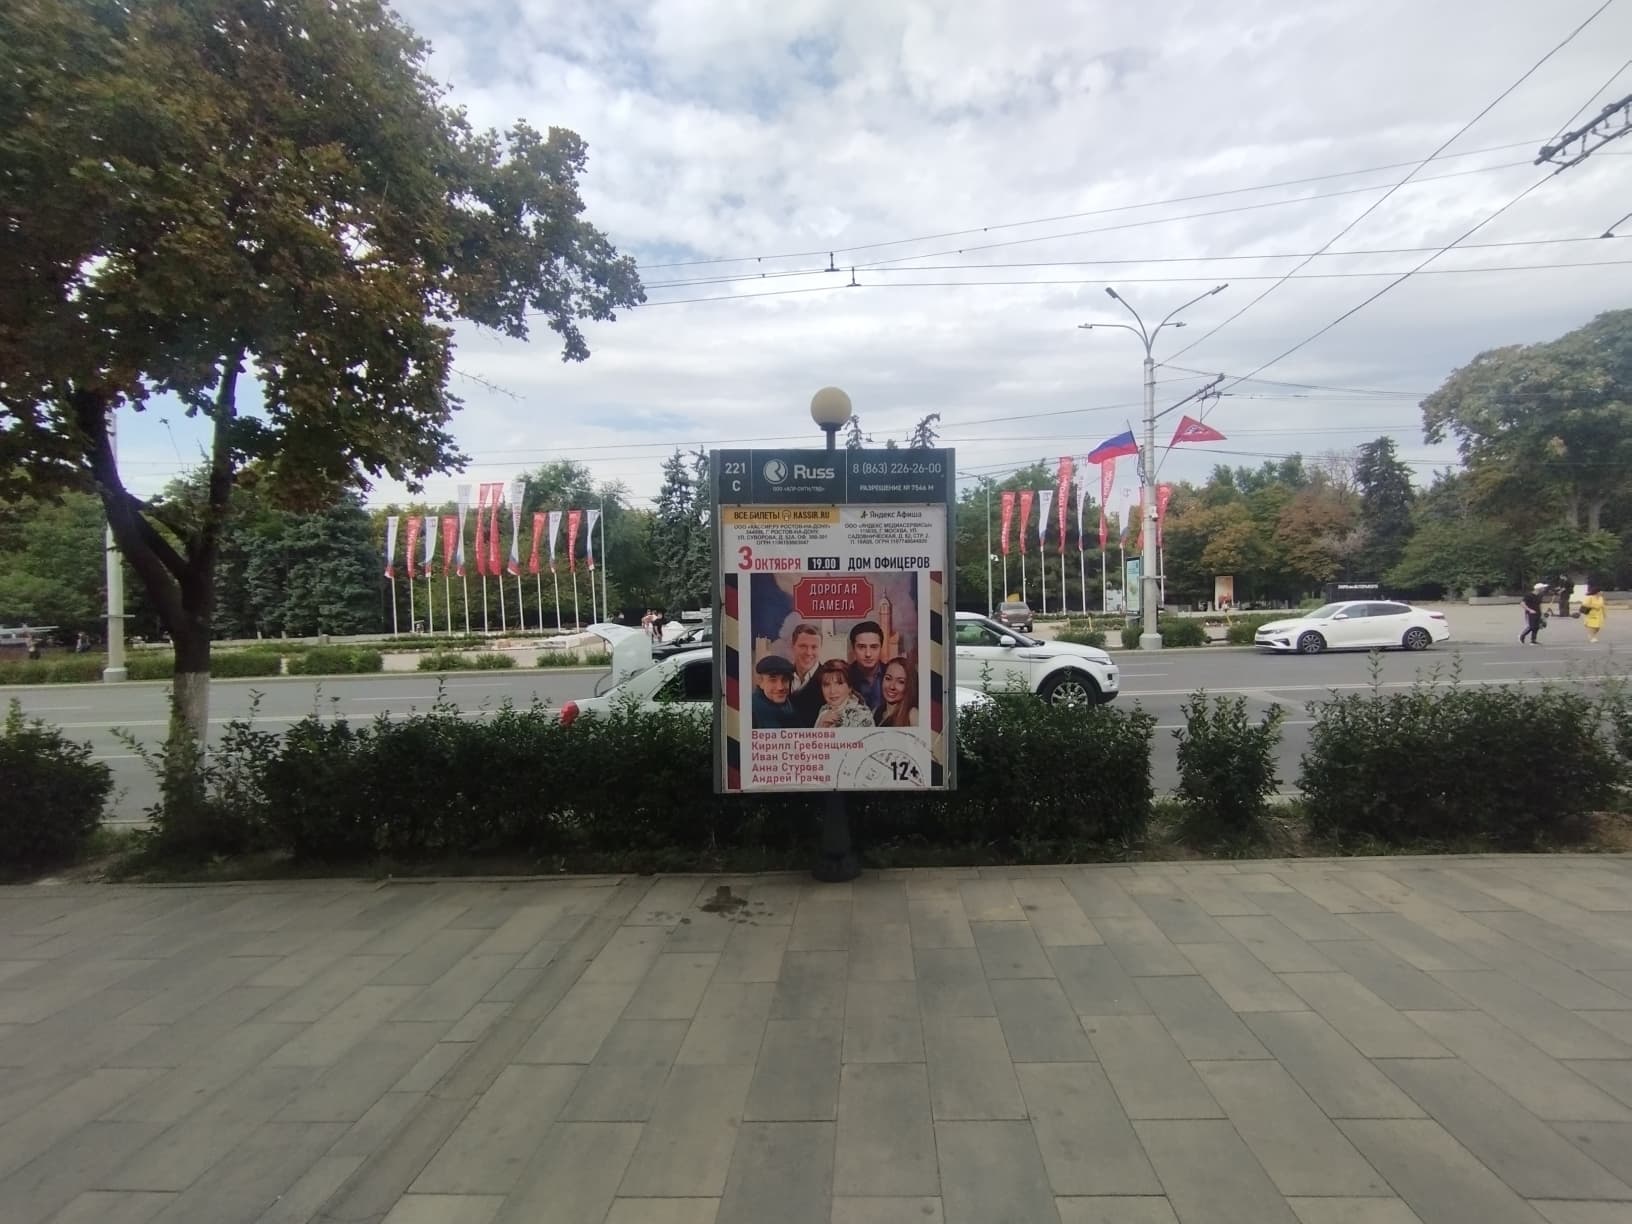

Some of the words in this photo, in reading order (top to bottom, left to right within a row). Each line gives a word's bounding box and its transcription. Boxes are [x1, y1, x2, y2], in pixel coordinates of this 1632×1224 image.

[725, 462, 746, 474] 221
[793, 464, 835, 479] Russ
[852, 463, 860, 474] 8
[862, 462, 888, 475] (863)
[891, 463, 942, 474] 226-26-00
[734, 511, 748, 520] ВСЕ
[749, 511, 780, 520] БИЛЕТЫ
[793, 511, 830, 520] KASSIR.RU
[869, 510, 895, 519] Яндекс
[896, 510, 922, 519] Афиша
[738, 546, 753, 570] 3
[754, 557, 801, 571] ОКТЯБРЯ
[811, 558, 837, 569] 19.00
[847, 557, 871, 571] ДОМ
[874, 556, 931, 571] ОФИЦЕРОВ
[809, 583, 858, 596] ДОРОГАЯ
[812, 599, 856, 611] ПАМЕЛА
[752, 730, 777, 741] Вера
[780, 730, 836, 740] Сотникова
[752, 741, 791, 751] Кирилл
[794, 740, 864, 752] Гребенщиков
[752, 752, 778, 761] Иван
[781, 751, 831, 763] Стебунов
[752, 763, 778, 772] Анна
[781, 762, 825, 773] Стурова
[890, 761, 919, 781] 12+
[752, 772, 792, 784] Андрей
[795, 773, 831, 784] Грачев
